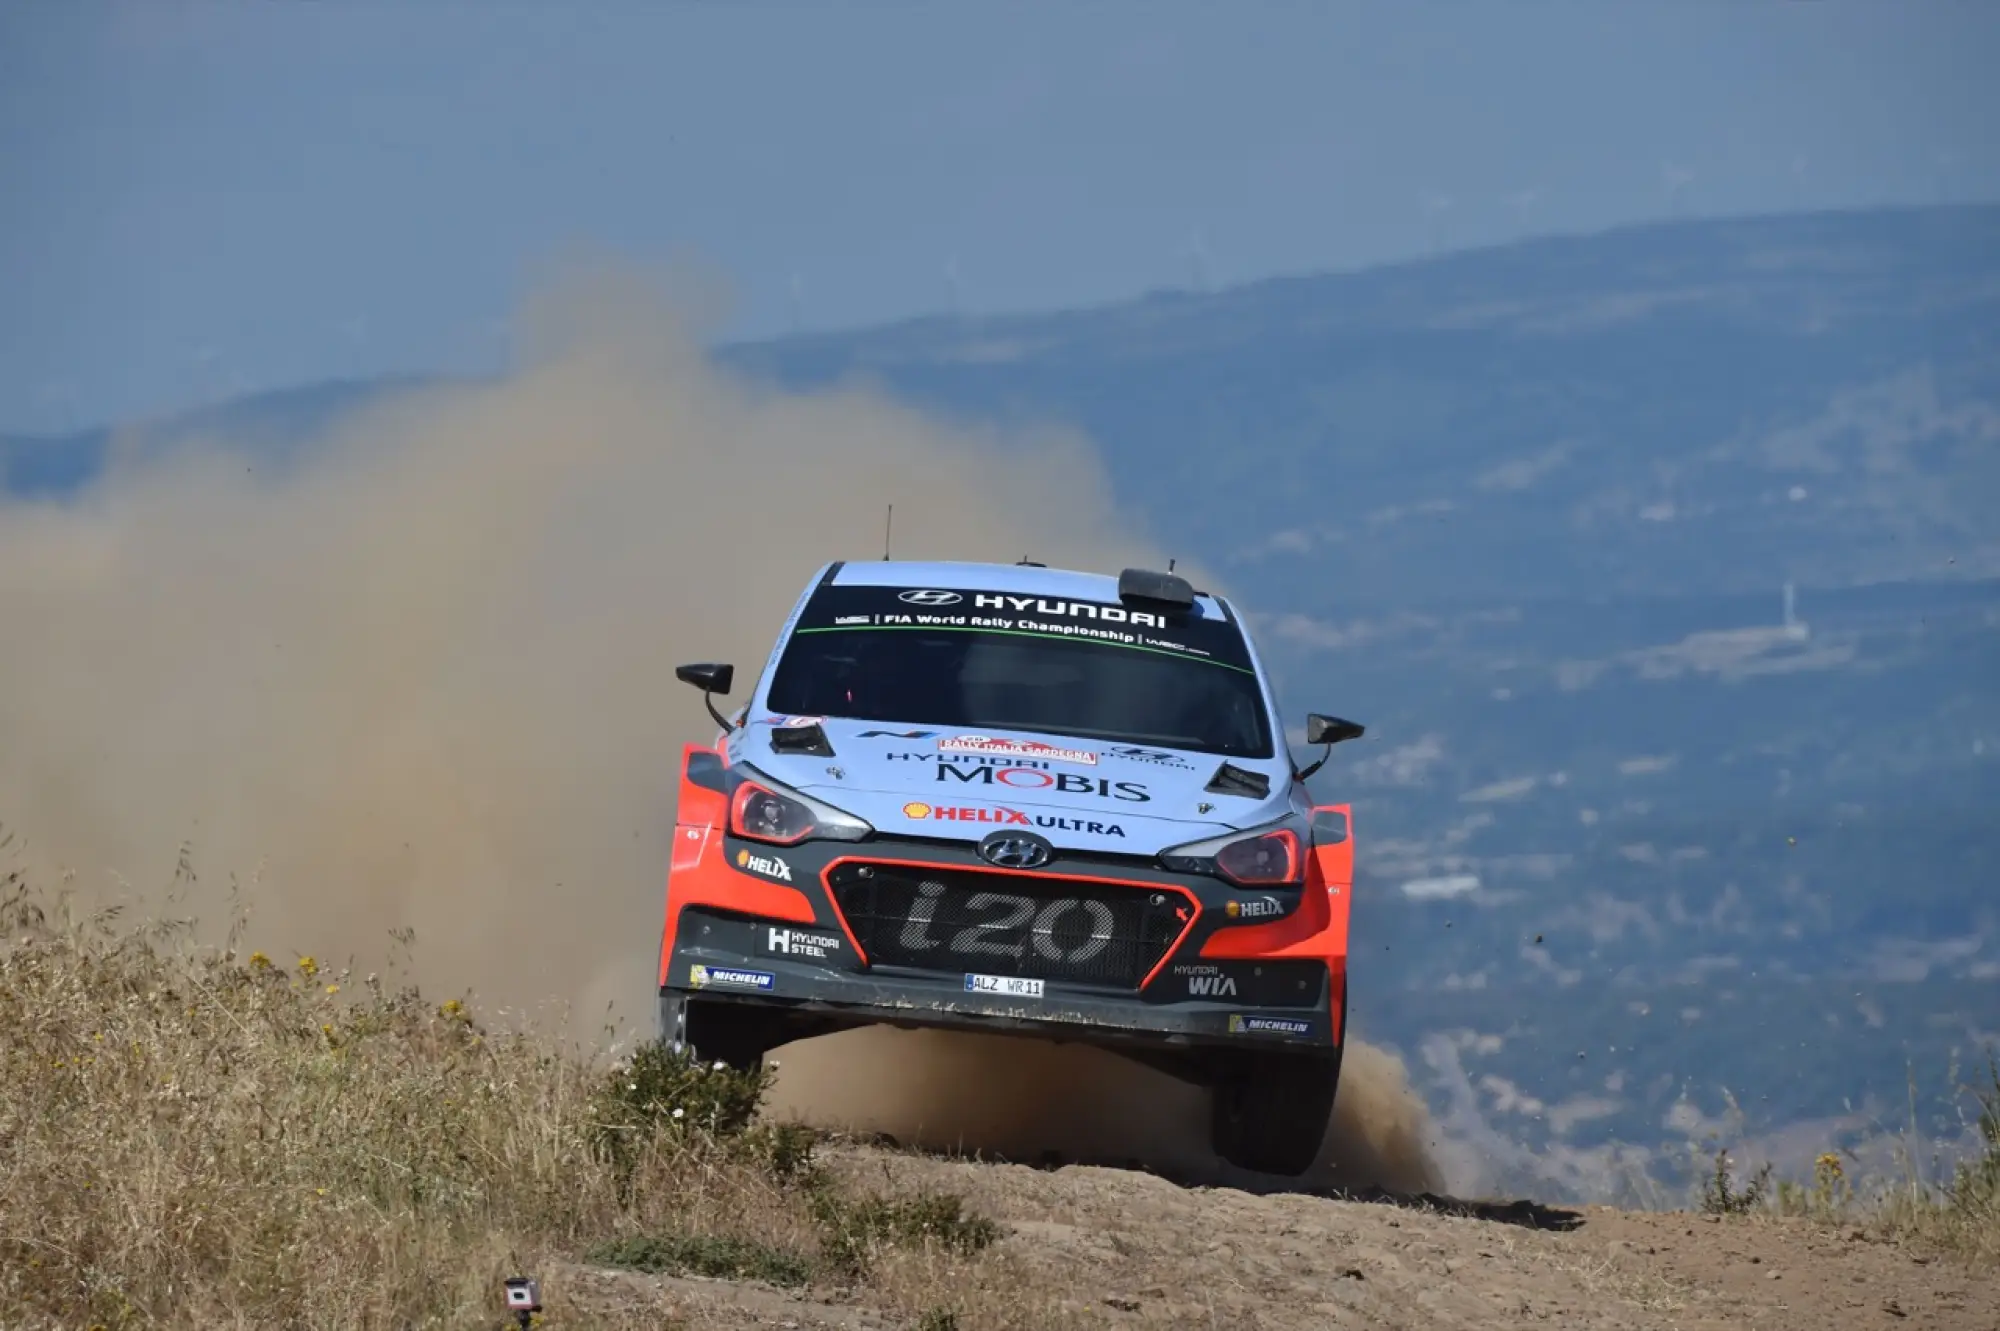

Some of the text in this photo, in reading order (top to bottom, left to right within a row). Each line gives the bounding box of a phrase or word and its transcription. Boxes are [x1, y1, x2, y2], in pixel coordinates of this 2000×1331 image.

[974, 594, 1166, 629] HYUNDAI
[884, 615, 1134, 643] FIA World Rally Championship
[944, 739, 980, 749] RALLY
[983, 742, 1023, 753] ITALIA
[1025, 748, 1092, 761] SARDEGNA
[886, 752, 1049, 770] HYUNDAI
[936, 763, 1151, 802] MOBIS
[934, 805, 1126, 838] HELIX ULTRA
[747, 855, 792, 882] HELIX
[1240, 896, 1285, 917] HELIX
[899, 878, 1115, 963] i20
[791, 932, 840, 949] HYUNDAI
[791, 943, 828, 958] STEEL
[712, 970, 771, 985] MICHELIN
[1174, 965, 1218, 975] HYUNDAI
[973, 977, 999, 991] ALZ
[1188, 973, 1237, 996] WIA
[1247, 1018, 1308, 1032] MICHELIN
